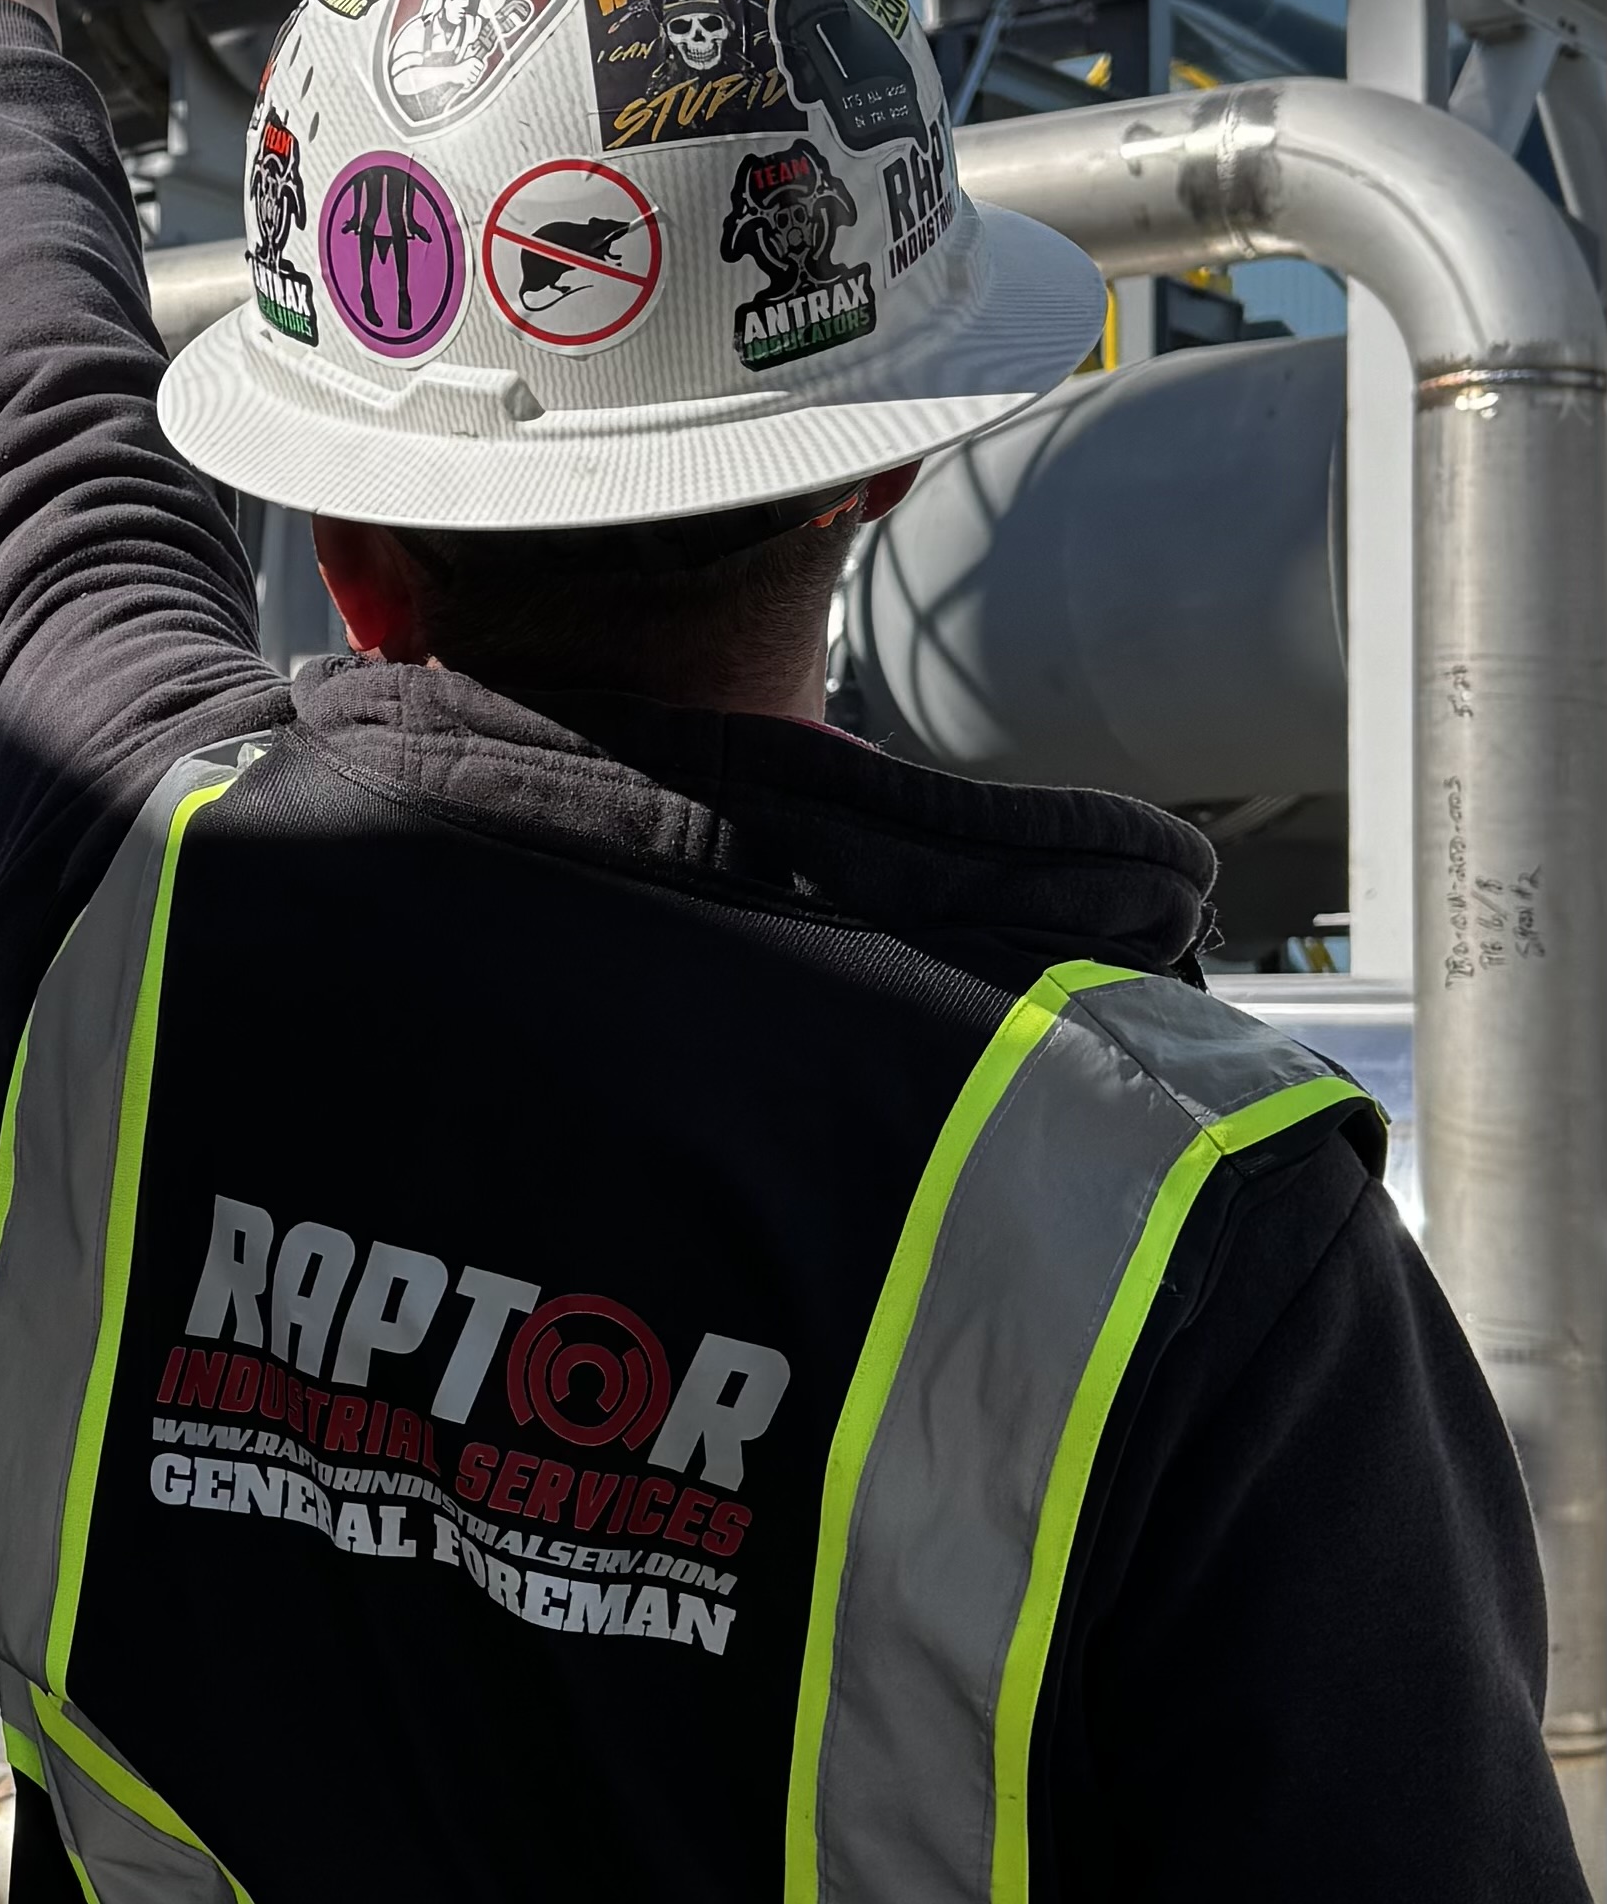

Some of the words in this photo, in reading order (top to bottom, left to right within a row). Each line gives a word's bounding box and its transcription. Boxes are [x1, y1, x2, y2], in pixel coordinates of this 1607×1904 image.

[609, 37, 656, 63] CAN
[752, 156, 810, 190] TEAM
[745, 274, 869, 343] ANTRAX
[185, 1194, 791, 1492] RAPTOR
[156, 1346, 442, 1473] INDUSTRIAL
[454, 1442, 753, 1557] SERVICES
[149, 1452, 417, 1558] GENERAL
[432, 1513, 737, 1656] FOREMAN
